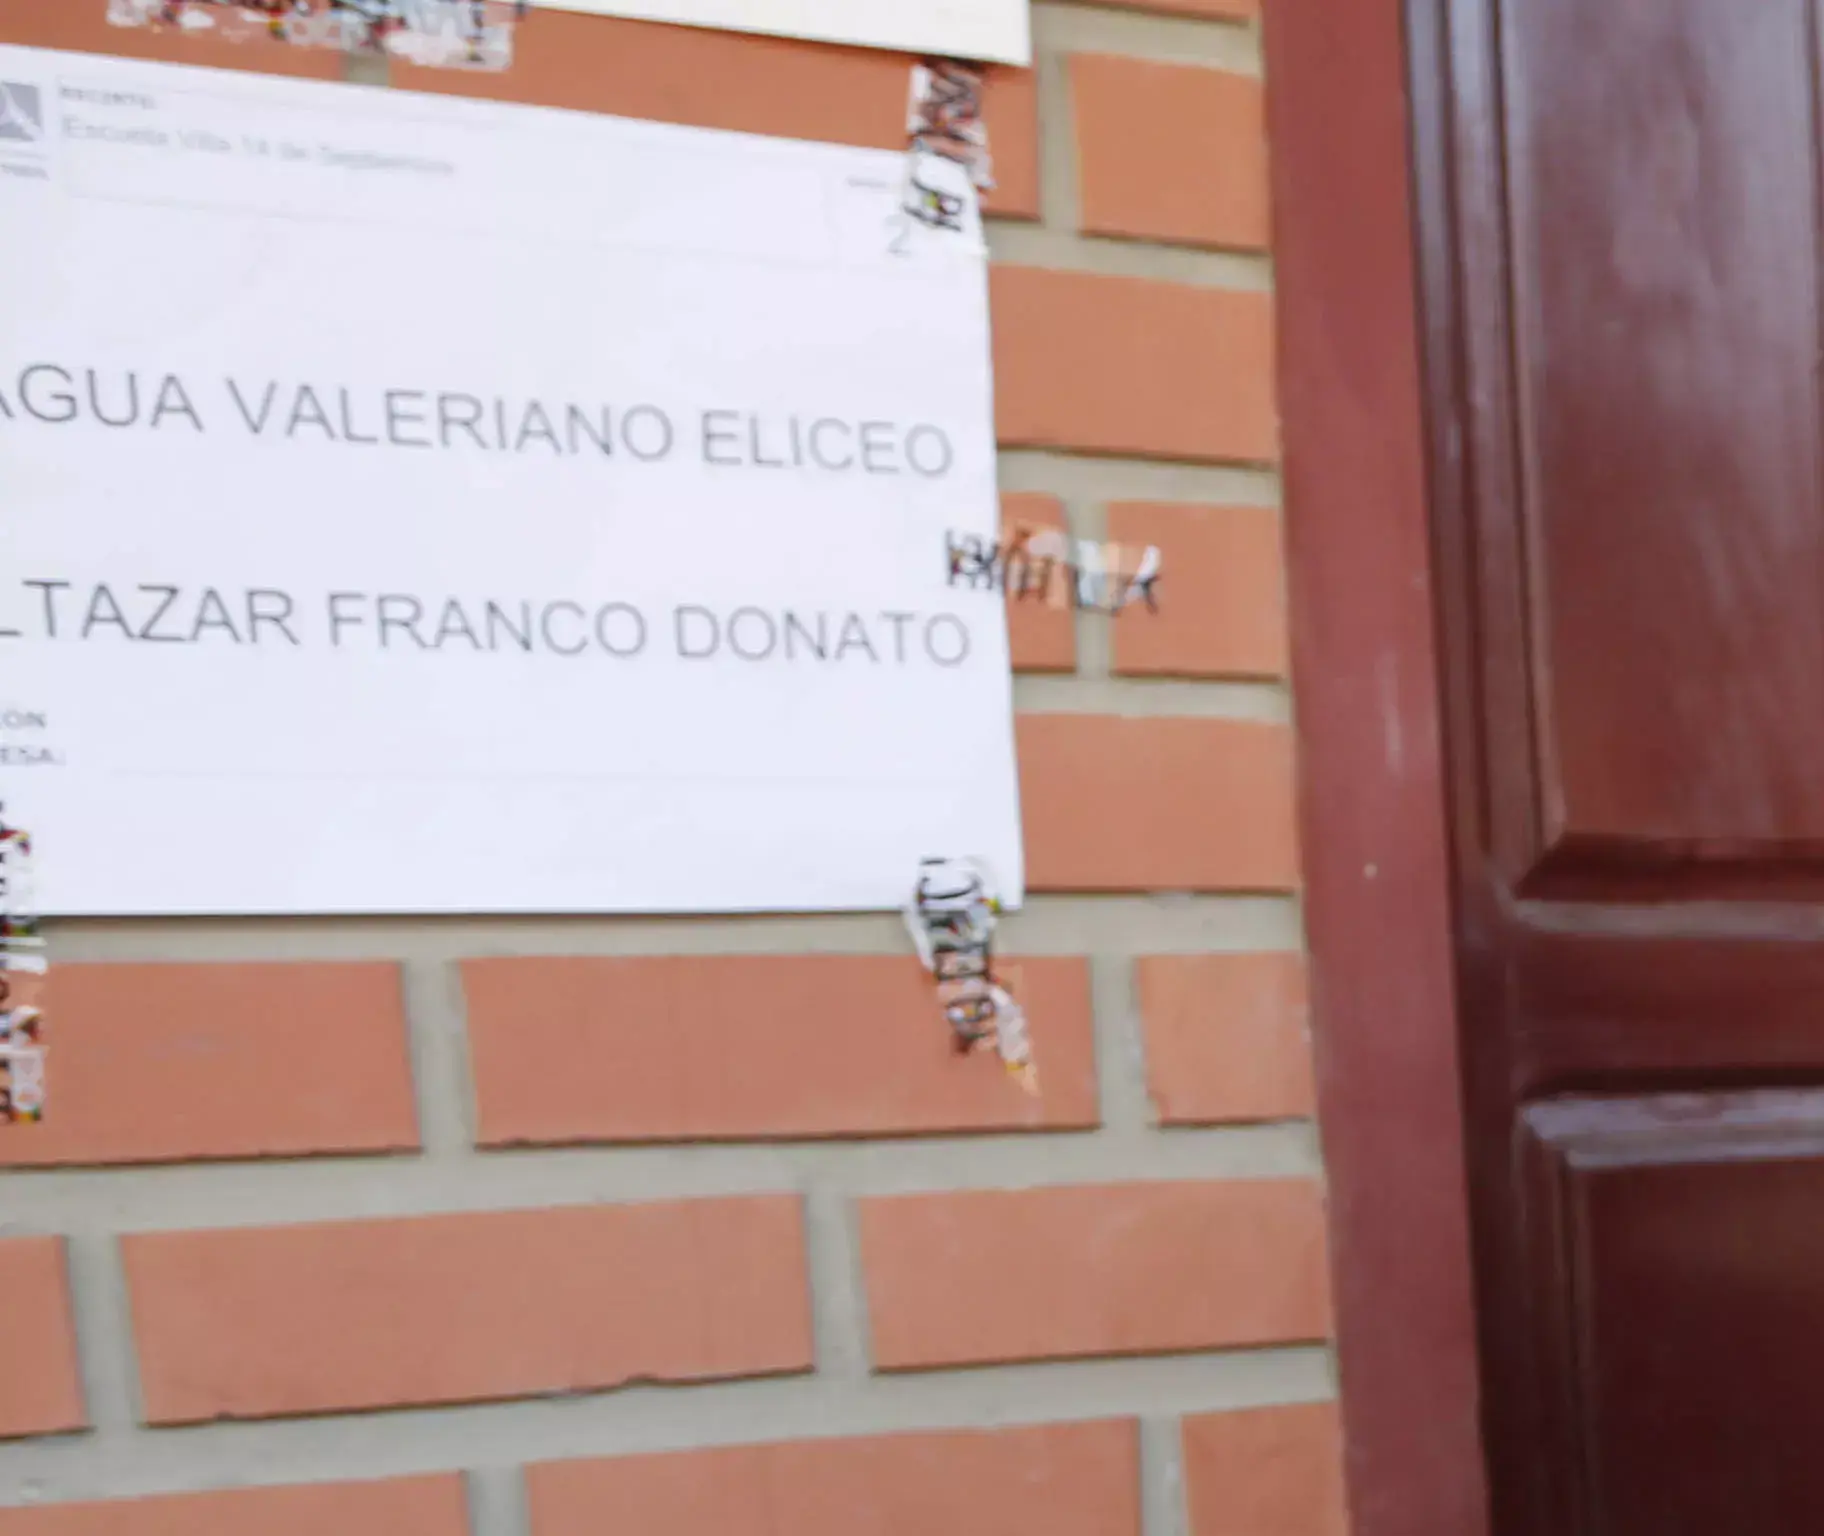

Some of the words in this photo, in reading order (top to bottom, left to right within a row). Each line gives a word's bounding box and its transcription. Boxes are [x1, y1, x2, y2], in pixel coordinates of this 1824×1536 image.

[224, 377, 674, 463] VALERIANO
[699, 408, 954, 478] ELICEO
[327, 592, 648, 659] FRANCO
[673, 604, 971, 668] DONATO
